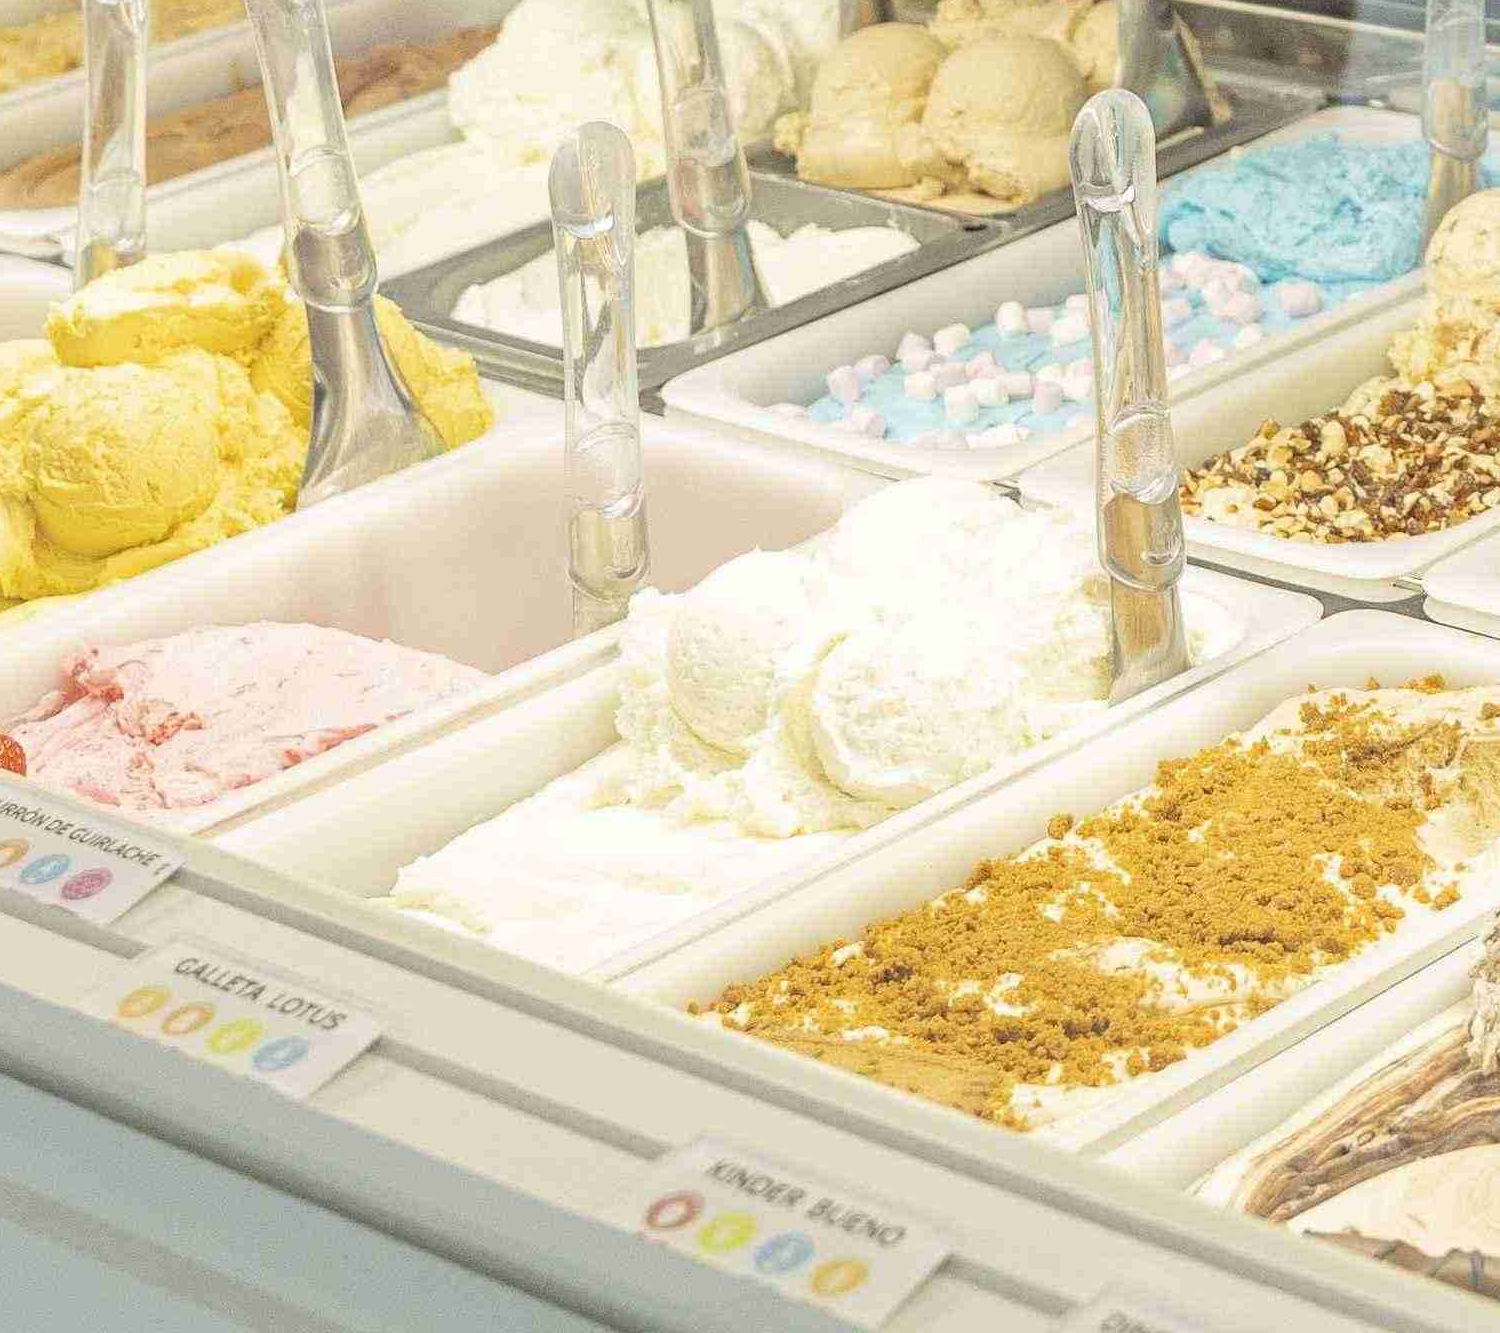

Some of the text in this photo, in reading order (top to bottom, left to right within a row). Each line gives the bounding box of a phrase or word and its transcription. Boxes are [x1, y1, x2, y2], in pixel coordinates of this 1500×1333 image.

[46, 818, 74, 835] DE
[68, 827, 162, 868] GUIRLACHE
[174, 957, 348, 1031] GALLETA LOTUS
[706, 1158, 909, 1247] KINDER BUENO
